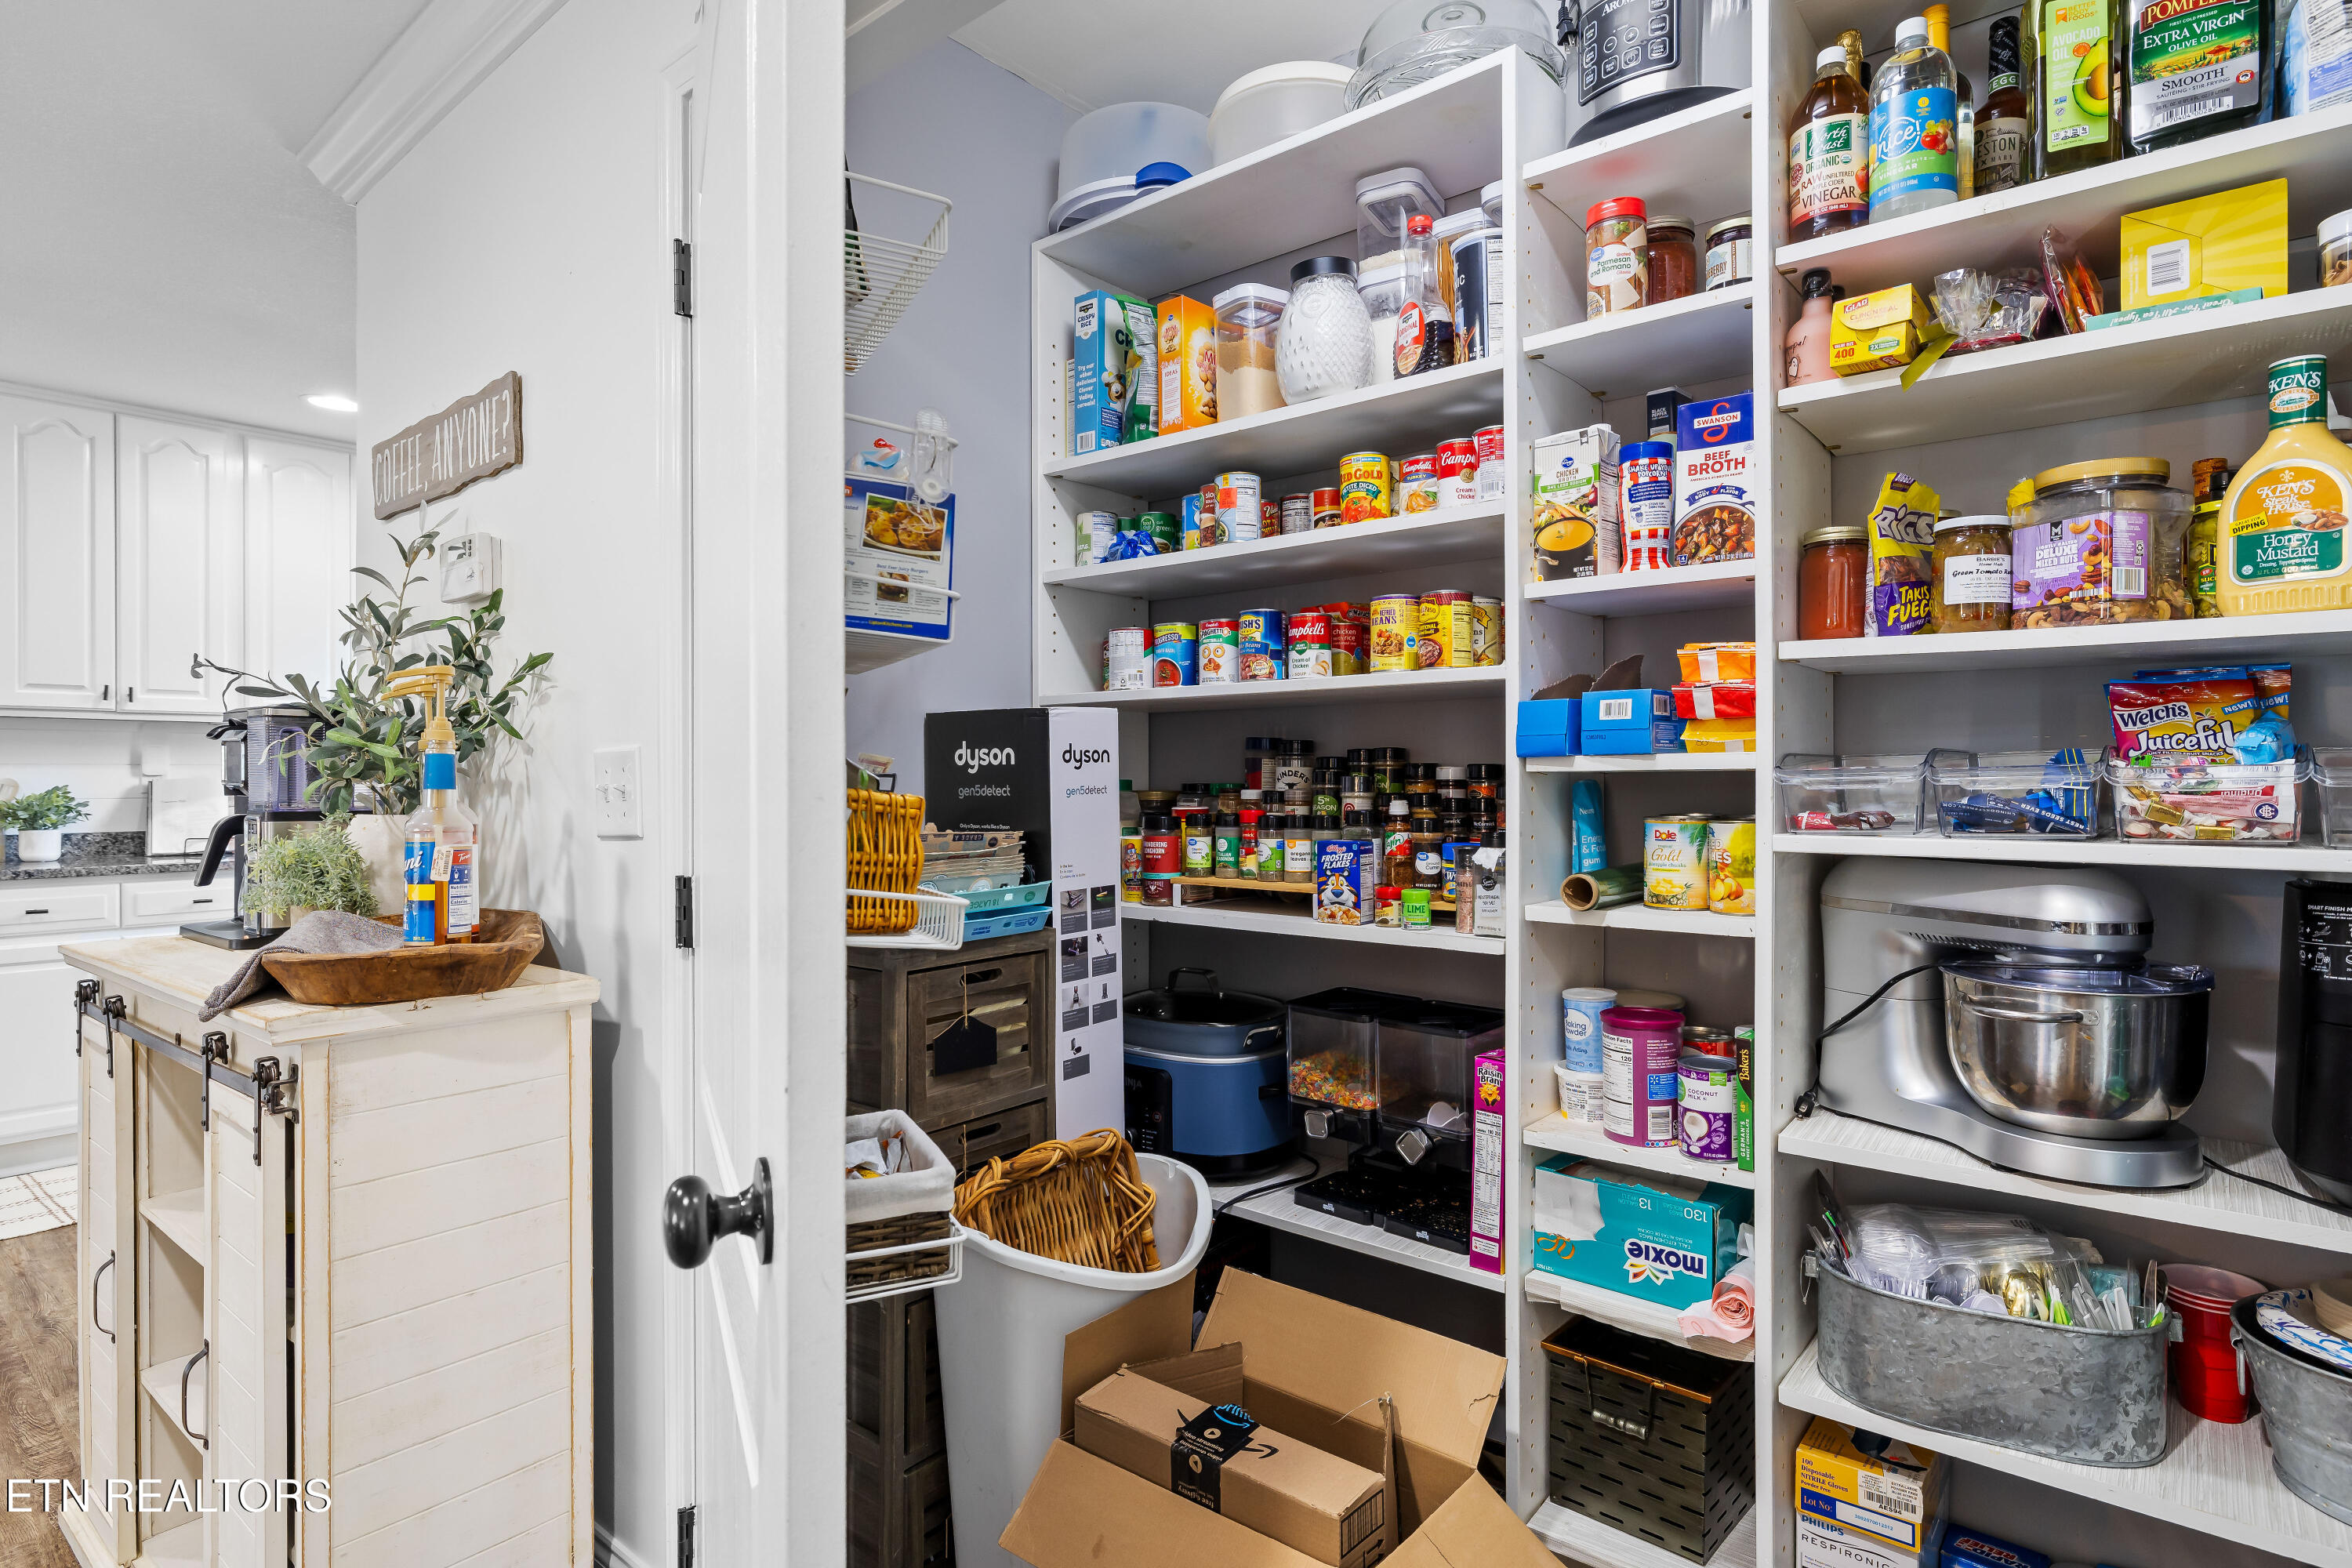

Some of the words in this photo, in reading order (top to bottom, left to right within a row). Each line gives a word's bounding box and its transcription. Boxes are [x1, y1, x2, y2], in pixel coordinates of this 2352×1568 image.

[2068, 1, 2096, 11] BETTER
[2068, 8, 2089, 16] BODY
[2068, 12, 2095, 22] FOODS
[2196, 9, 2218, 20] PRESSED
[2143, 27, 2190, 49] EXTRA
[2192, 9, 2245, 34] VIRGIN
[2053, 26, 2100, 48] AVOCADO
[2169, 38, 2198, 53] OLIVE
[2201, 33, 2217, 43] OIL
[2053, 47, 2070, 61] OIL
[2161, 67, 2225, 92] SMOOTH
[1878, 120, 1921, 157] nice!
[1806, 155, 1839, 174] ORGANIC
[1879, 162, 1918, 180] VINEGAR
[1802, 172, 1823, 191] RAW
[1823, 171, 1854, 180] UNFILTERED
[1812, 182, 1828, 191] APPLE
[1802, 186, 1857, 209] VINEGAR
[1598, 256, 1631, 267] Parmesan
[1590, 269, 1601, 278] and
[1602, 263, 1632, 273] Romano
[1845, 298, 1868, 314] GLAD
[1399, 319, 1418, 339] ORIGINAL
[1834, 347, 1855, 359] 400
[1164, 368, 1178, 377] IDEAS
[2269, 371, 2321, 393] KEN'S
[1697, 413, 1738, 427] SWANSON
[375, 433, 428, 506] COFFEE,
[432, 390, 510, 481] ANYONE?
[1704, 450, 1730, 462] BEEF
[1403, 461, 1432, 472] Campbell's
[1556, 467, 1579, 477] CHICKEN
[1628, 465, 1649, 474] SHAKE
[1661, 463, 1672, 472] YOU
[1688, 456, 1746, 477] BROTH
[1353, 468, 1383, 480] GOLD
[1637, 470, 1668, 478] POPCORN!
[1342, 483, 1359, 493] PETITE
[1359, 482, 1377, 492] DICED
[2256, 478, 2316, 499] KEN'S
[2263, 495, 2299, 510] Steak
[2267, 499, 2310, 515] House
[2232, 519, 2266, 535] DIPPING
[2263, 532, 2312, 550] Honey
[2035, 545, 2078, 560] DELUXE
[2256, 541, 2319, 562] Mustard
[2035, 557, 2057, 568] MIXED
[2059, 554, 2078, 566] NUTS
[1899, 585, 1930, 604] TAKIS
[1380, 608, 1396, 617] REFRIED
[1240, 619, 1261, 630] USH'S
[1372, 616, 1397, 626] BEANS
[2117, 704, 2189, 728] Welch's
[954, 740, 1015, 775] dyson
[1062, 742, 1110, 770] dyson
[1277, 770, 1309, 784] KINDER'S
[958, 785, 1011, 799] gen5detect
[1066, 785, 1108, 798] gen5detect
[2021, 804, 2038, 814] EVER
[2042, 810, 2064, 822] SEEDS
[1654, 829, 1677, 840] Dole
[1321, 852, 1353, 863] FROSTED
[1583, 857, 1601, 866] gum
[1651, 848, 1682, 862] Gold
[1323, 861, 1350, 869] FLAKES
[1406, 905, 1425, 913] LIME
[1739, 1049, 1749, 1082] Baker's
[1478, 1066, 1503, 1081] Raisin
[1479, 1074, 1501, 1087] Bran
[1687, 1088, 1718, 1097] COCONUT
[1639, 1197, 1652, 1210] 13
[1684, 1207, 1708, 1223] 130
[1655, 1236, 1681, 1247] KITCHEN
[1628, 1241, 1704, 1275] moxie
[1196, 1438, 1225, 1452] streaming
[1801, 1457, 1813, 1467] 100
[1801, 1465, 1835, 1481] Disposable
[1800, 1472, 1826, 1486] NITRILE
[1828, 1480, 1849, 1493] Gloves
[1800, 1479, 1818, 1490] Powder
[1820, 1486, 1831, 1494] Free
[1803, 1495, 1817, 1508] Lot
[1818, 1500, 1833, 1513] No:
[1878, 1504, 1902, 1515] AES94
[1802, 1515, 1844, 1537] PHILIPS
[1802, 1534, 1896, 1568] RESPIRONIC
